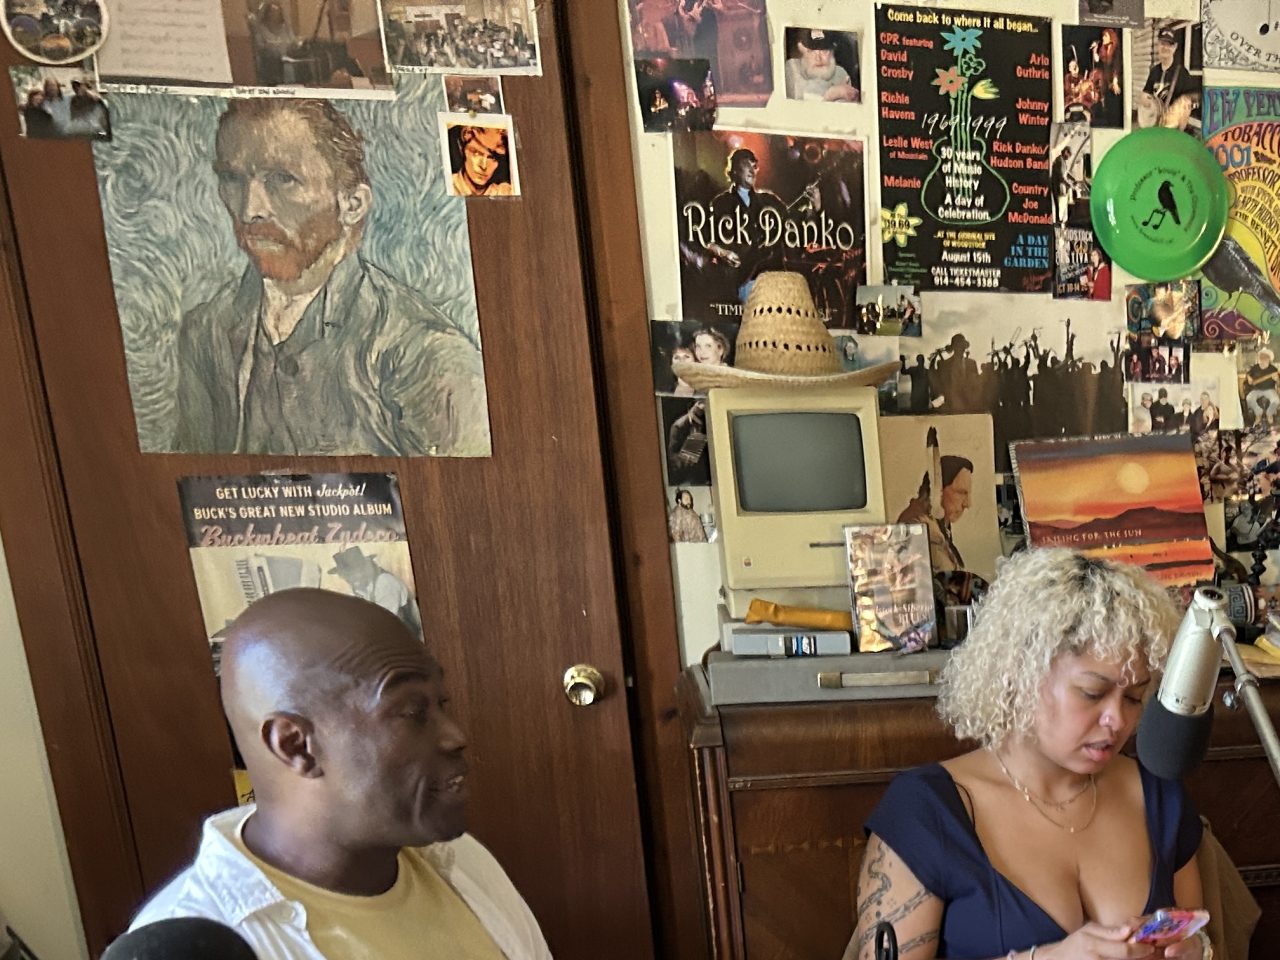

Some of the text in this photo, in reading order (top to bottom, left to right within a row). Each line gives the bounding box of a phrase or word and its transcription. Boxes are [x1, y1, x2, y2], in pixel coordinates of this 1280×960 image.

[888, 8, 914, 22] Come
[916, 10, 939, 24] back
[941, 12, 951, 25] to
[953, 14, 982, 28] where
[993, 16, 1005, 29] all
[880, 32, 934, 49] CPR featuring
[1230, 32, 1262, 59] OVER
[880, 50, 907, 63] David
[1029, 53, 1050, 66] Arlo
[880, 66, 913, 81] Crosby
[1016, 66, 1050, 80] Guthrie
[881, 91, 910, 105] Richie
[1016, 99, 1050, 113] Johnny
[881, 107, 916, 121] Havens
[1018, 113, 1050, 126] Winter
[883, 135, 934, 149] Leslie West
[992, 140, 1013, 153] Rick
[940, 147, 981, 163] 30 years
[941, 163, 952, 174] of
[990, 156, 1049, 170] Hudson Band
[884, 174, 922, 189] Melanie
[945, 176, 980, 190] History
[1012, 182, 1049, 197] Country
[944, 193, 985, 207] A day of
[1022, 198, 1039, 210] Joe
[1008, 211, 1053, 225] McDonald
[683, 201, 855, 250] Rick Danko
[1016, 234, 1025, 245] A
[1026, 234, 1049, 246] DAY
[941, 250, 991, 264] August 15th
[1010, 246, 1023, 256] IN
[1026, 246, 1049, 257] THE
[1004, 256, 1049, 269] GARDEN
[931, 266, 948, 277] CALL
[949, 267, 1001, 279] TICKETMASTER
[216, 487, 238, 500] GET
[242, 486, 279, 499] LUCKY
[283, 485, 312, 498] WITH
[193, 503, 393, 520] BUCK'S GREAT NEW STUDIO ALBUM
[199, 522, 400, 551] Buckwheat Zydeco
[1081, 531, 1100, 541] FOR
[1103, 530, 1121, 539] THE
[1123, 528, 1142, 538] SUN
